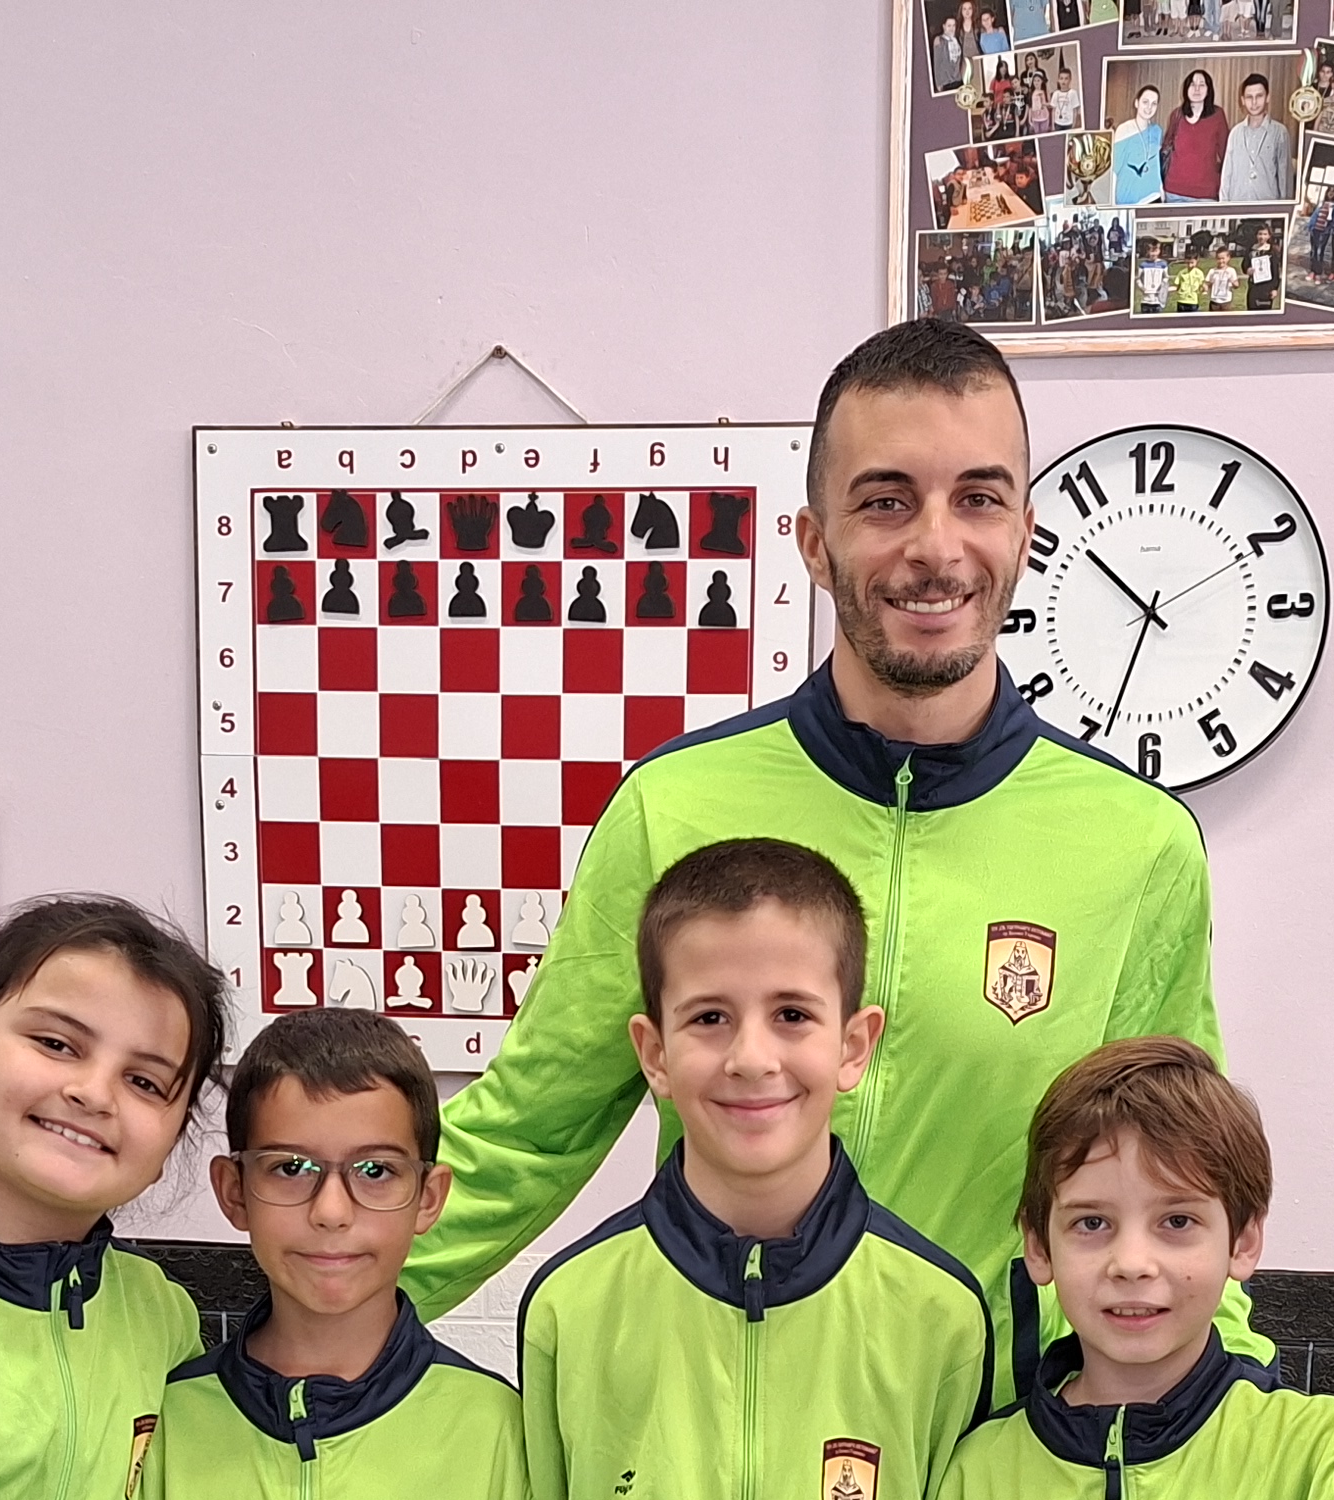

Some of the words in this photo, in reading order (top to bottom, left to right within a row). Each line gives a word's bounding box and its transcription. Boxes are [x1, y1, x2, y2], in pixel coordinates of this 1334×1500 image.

[1129, 441, 1175, 494] 12
[1058, 460, 1109, 519] 11
[1209, 460, 1241, 509] 1
[217, 515, 232, 537] 8
[777, 514, 792, 536] 8
[1246, 513, 1297, 557] 2
[218, 582, 233, 602] 7
[774, 583, 790, 605] 7
[1267, 593, 1315, 619] 3
[219, 647, 235, 669] 6
[1248, 660, 1297, 701] 4
[220, 712, 236, 733] 5
[1197, 708, 1238, 757] 5
[1137, 732, 1162, 780] 6
[221, 778, 238, 799] 4
[224, 841, 239, 862] 3
[226, 904, 242, 925] 2
[230, 967, 241, 988] 1
[465, 1032, 481, 1054] d
